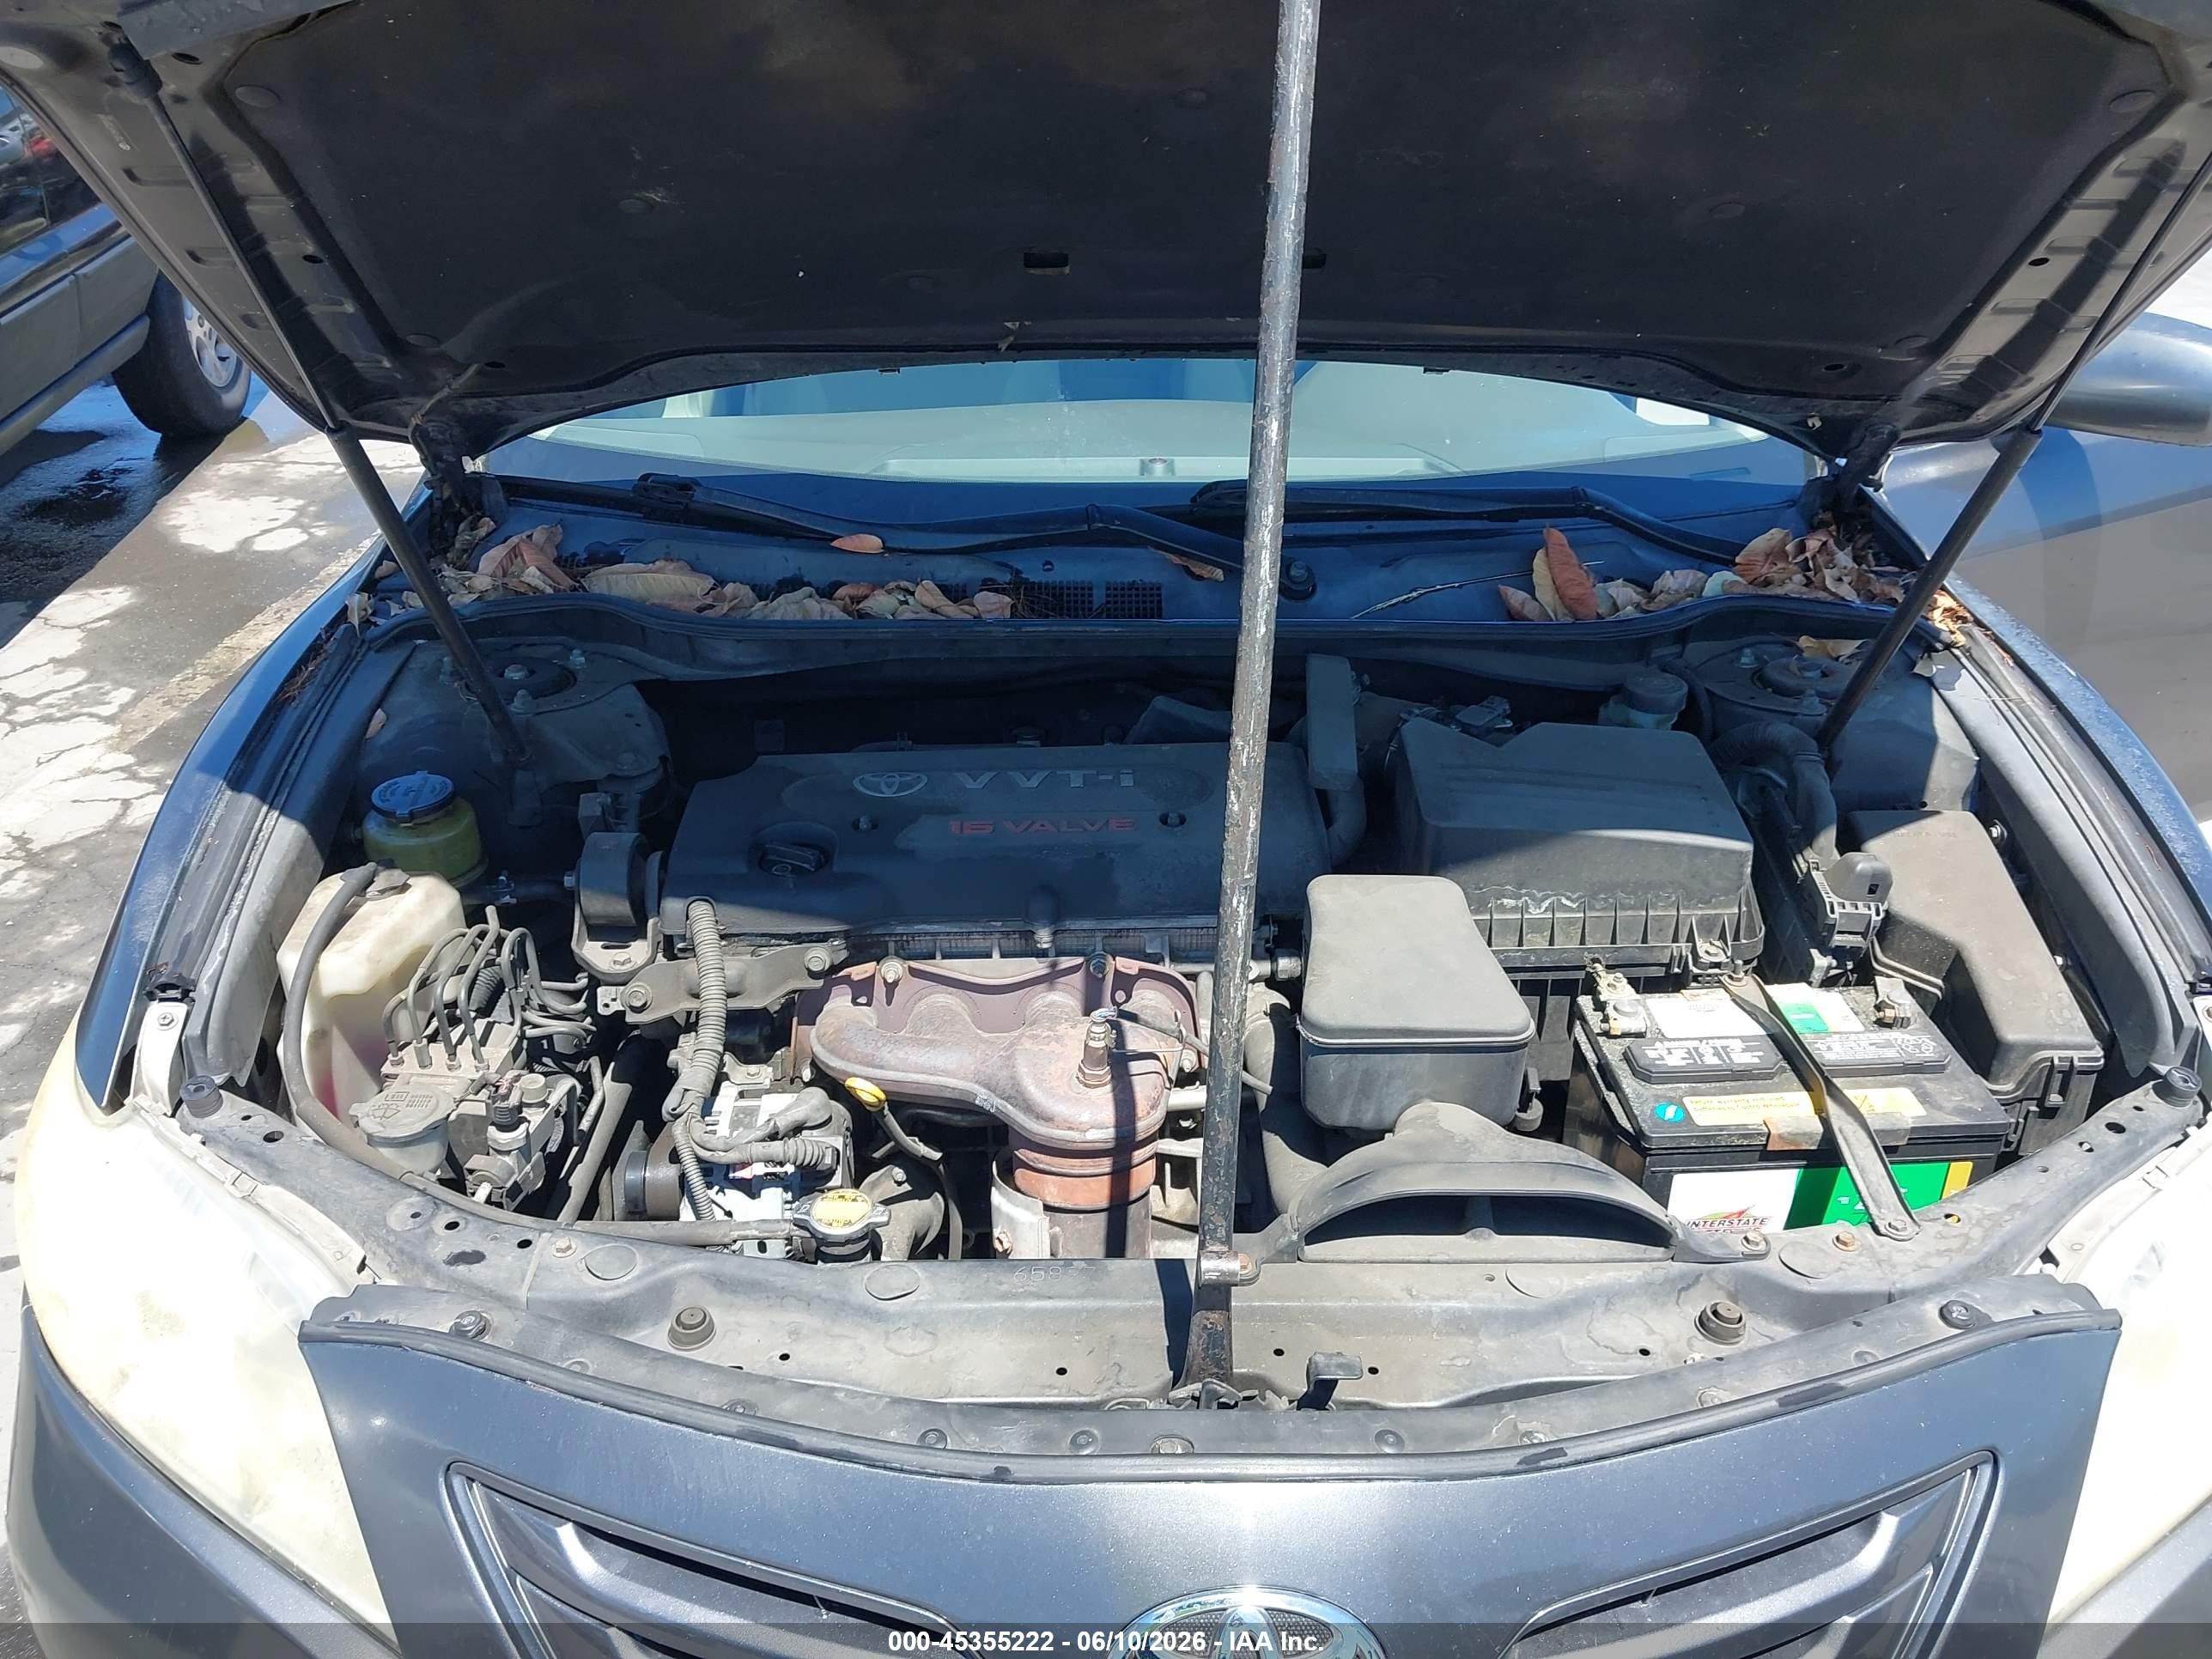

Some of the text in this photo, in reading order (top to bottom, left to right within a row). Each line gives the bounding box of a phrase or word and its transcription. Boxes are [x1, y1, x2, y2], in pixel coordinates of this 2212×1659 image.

[952, 770, 1134, 788] VVT-i
[950, 818, 1134, 834] 16 VALVE
[1686, 1218, 1768, 1228] INTERSTATE
